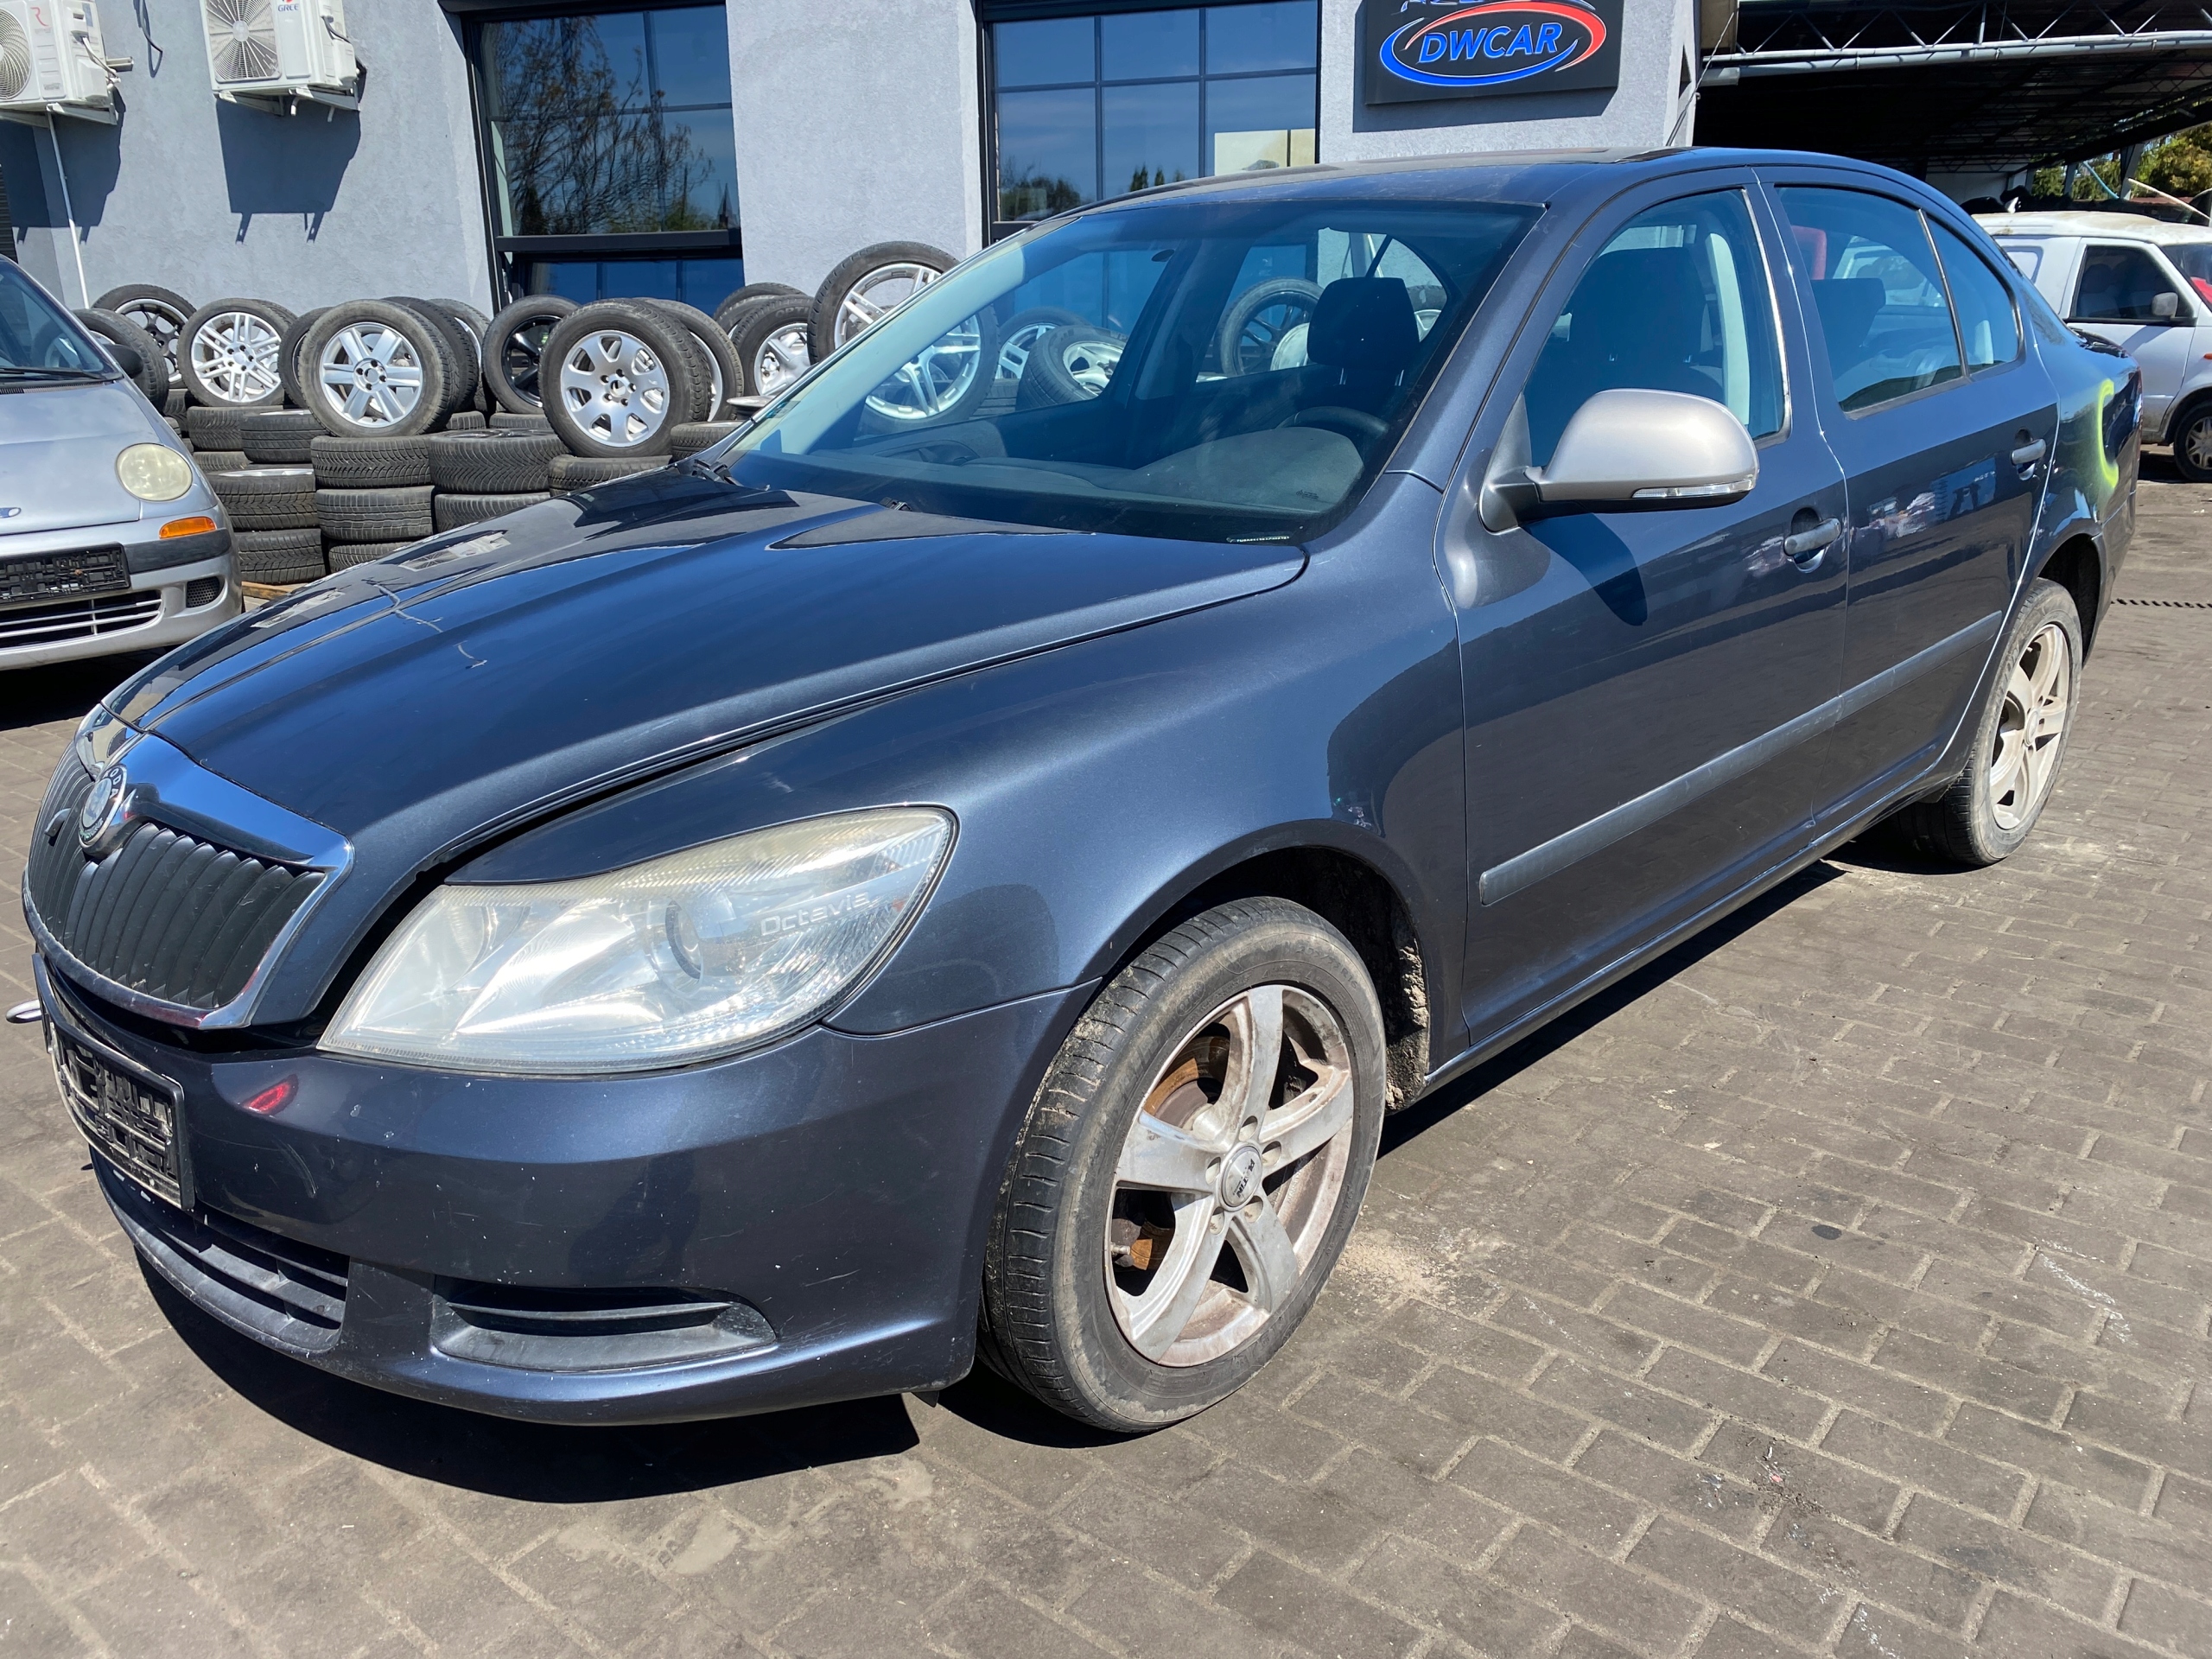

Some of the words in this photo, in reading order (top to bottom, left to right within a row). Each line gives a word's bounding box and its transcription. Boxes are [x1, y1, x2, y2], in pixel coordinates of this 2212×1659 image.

[1418, 22, 1563, 63] DWCAR
[775, 307, 810, 318] OPTI
[760, 892, 870, 935] Octavia
